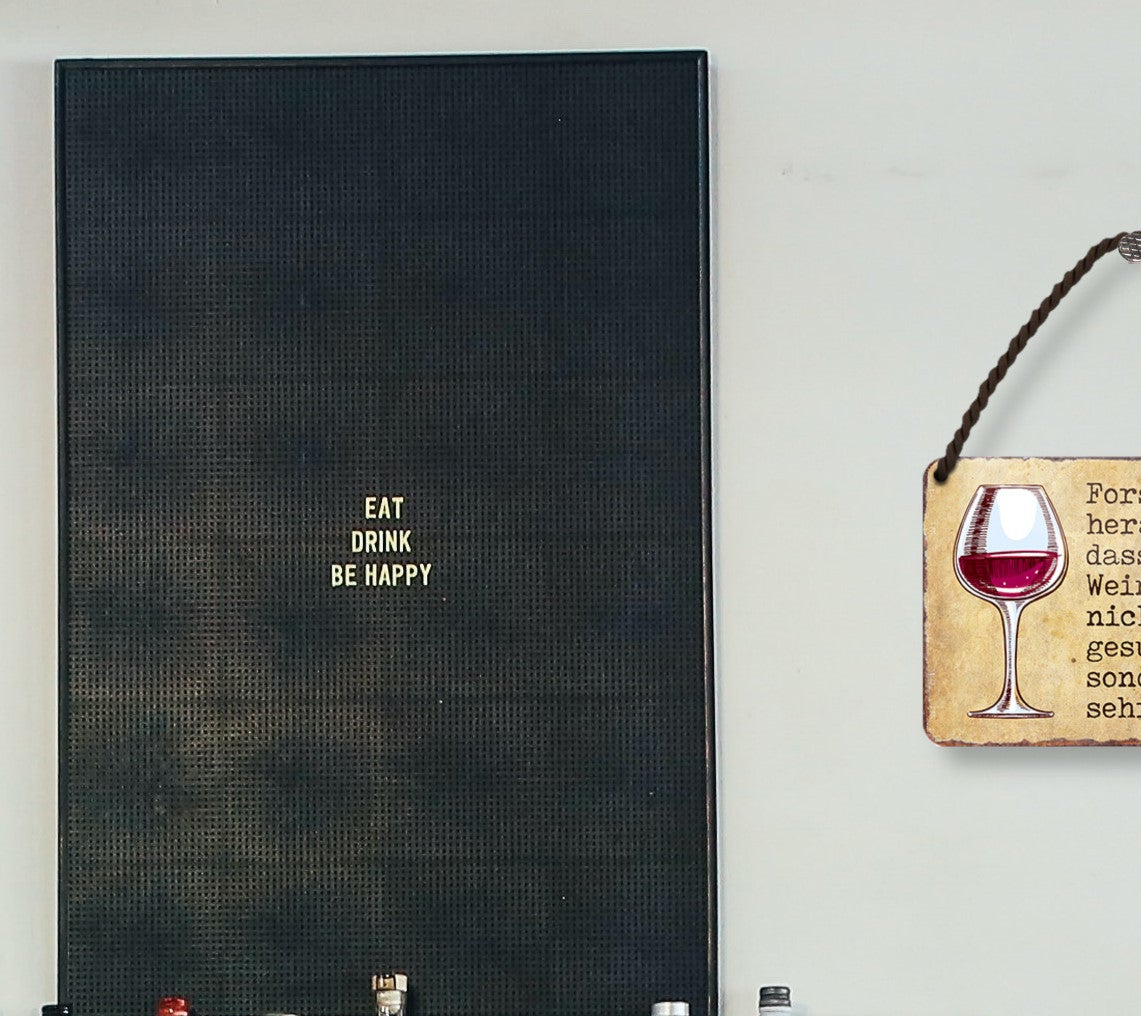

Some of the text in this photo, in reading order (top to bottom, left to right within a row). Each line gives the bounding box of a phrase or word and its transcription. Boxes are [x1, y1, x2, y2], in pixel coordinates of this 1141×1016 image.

[366, 497, 403, 519] EAT
[352, 530, 411, 553] DRINK
[332, 564, 431, 586] BE HAPPY
